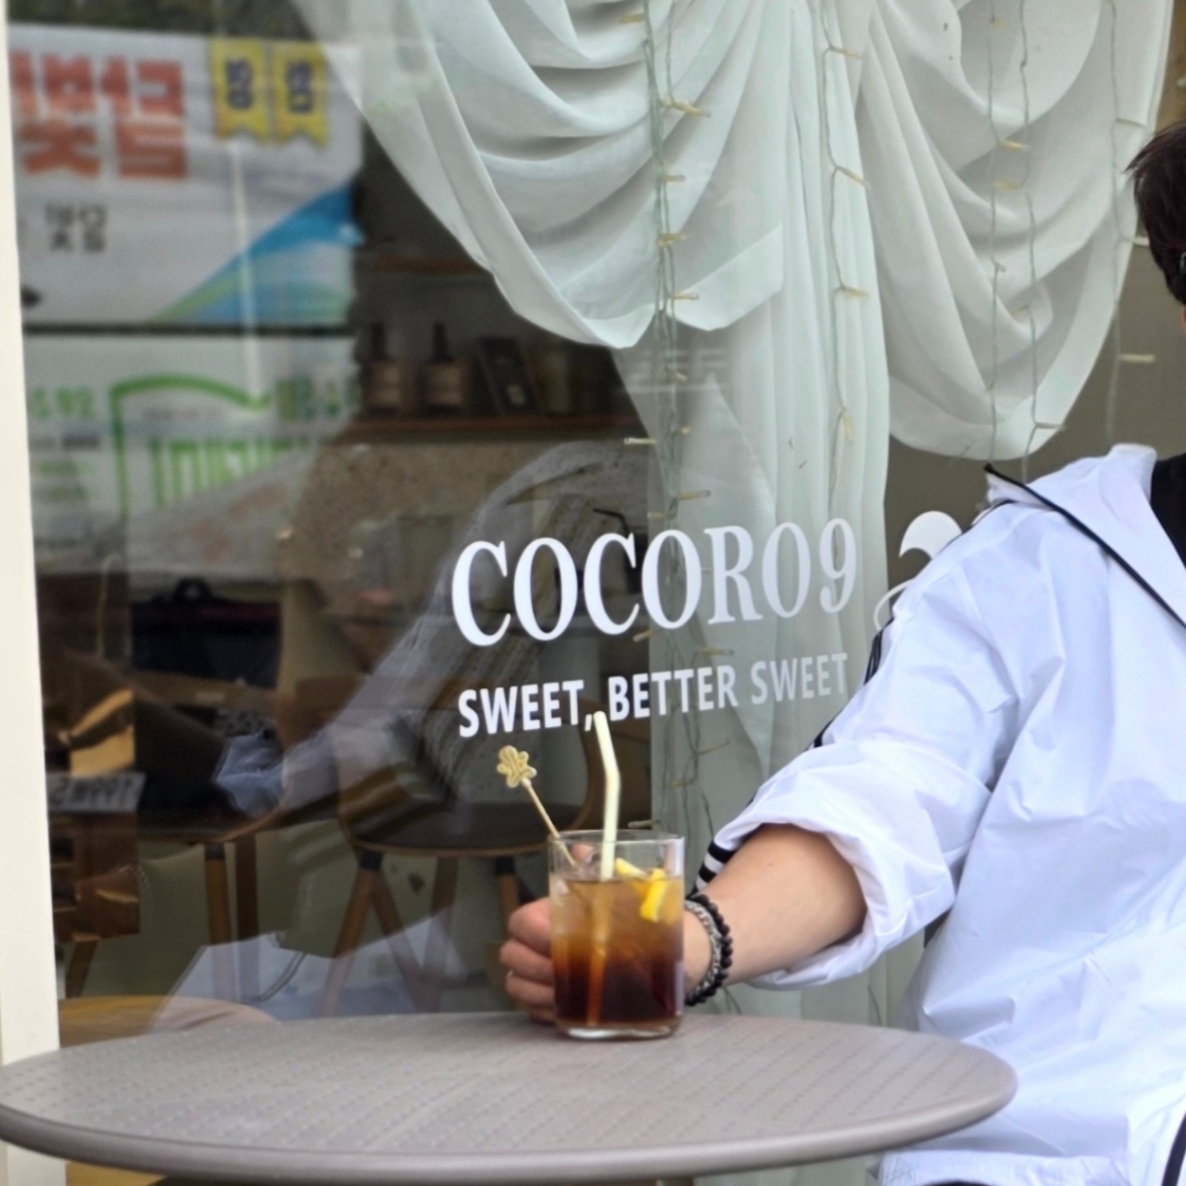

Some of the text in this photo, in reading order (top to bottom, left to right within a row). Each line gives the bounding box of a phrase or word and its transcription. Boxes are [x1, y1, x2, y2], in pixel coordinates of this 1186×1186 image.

[451, 517, 857, 647] COCORO9
[457, 652, 849, 738] SWEET, BETTER SWEET
